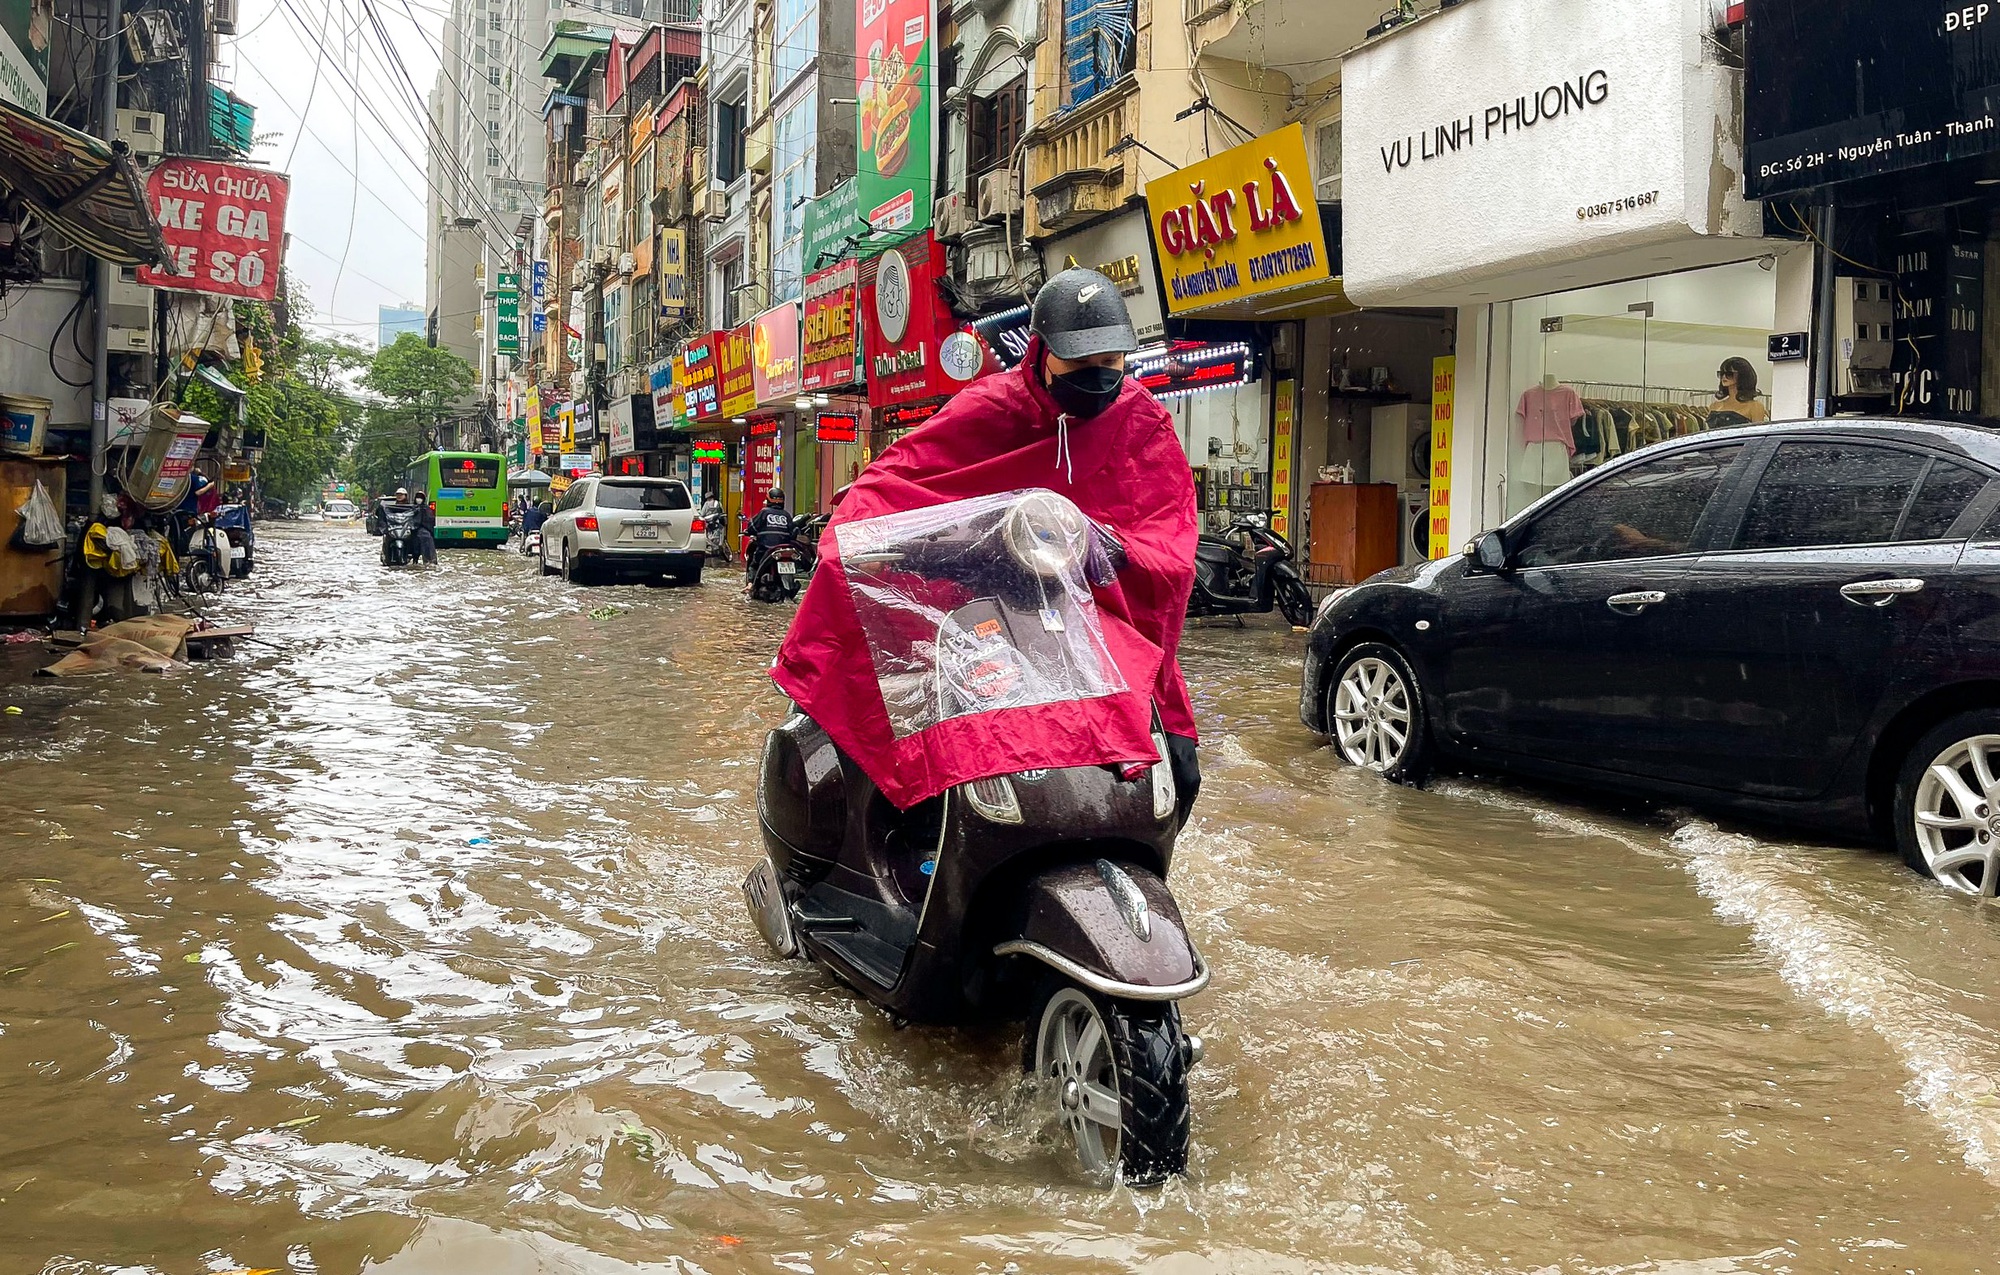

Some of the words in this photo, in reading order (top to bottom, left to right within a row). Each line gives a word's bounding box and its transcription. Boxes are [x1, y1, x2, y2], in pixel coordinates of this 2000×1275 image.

[1944, 3, 1989, 31] ĐẸP
[1381, 136, 1412, 173] VU
[1422, 115, 1473, 161] LINH
[1485, 69, 1608, 140] PHUONG
[1760, 161, 1783, 177] ĐC:
[1786, 155, 1802, 172] Số
[1807, 152, 1824, 167] 2H
[1838, 137, 1892, 161] Nguyễn
[1896, 130, 1932, 148] Tuân
[1945, 115, 1995, 137] Thanh
[163, 166, 210, 194] SỬA
[214, 176, 272, 203] CHỮA
[157, 196, 205, 231] XE
[216, 205, 270, 242] GA
[1161, 179, 1238, 259] GIẶT
[1242, 156, 1303, 232] LÀ
[210, 249, 268, 288] SỐ
[1897, 250, 1928, 274] HAIR
[1080, 283, 1099, 296] NIKE
[999, 325, 1031, 357] SA
[1781, 336, 1789, 348] 2
[1434, 373, 1453, 396] GIẶT
[1276, 395, 1291, 419] GIẶT
[1434, 402, 1451, 421] KHÔ
[1948, 387, 1972, 414] TẠO
[1277, 419, 1290, 436] KHÔ
[1437, 430, 1447, 449] LÀ
[1278, 442, 1287, 460] LÀ
[1434, 459, 1448, 478] HƠI
[1432, 486, 1449, 507] LÀM
[1432, 516, 1448, 535] MỚI
